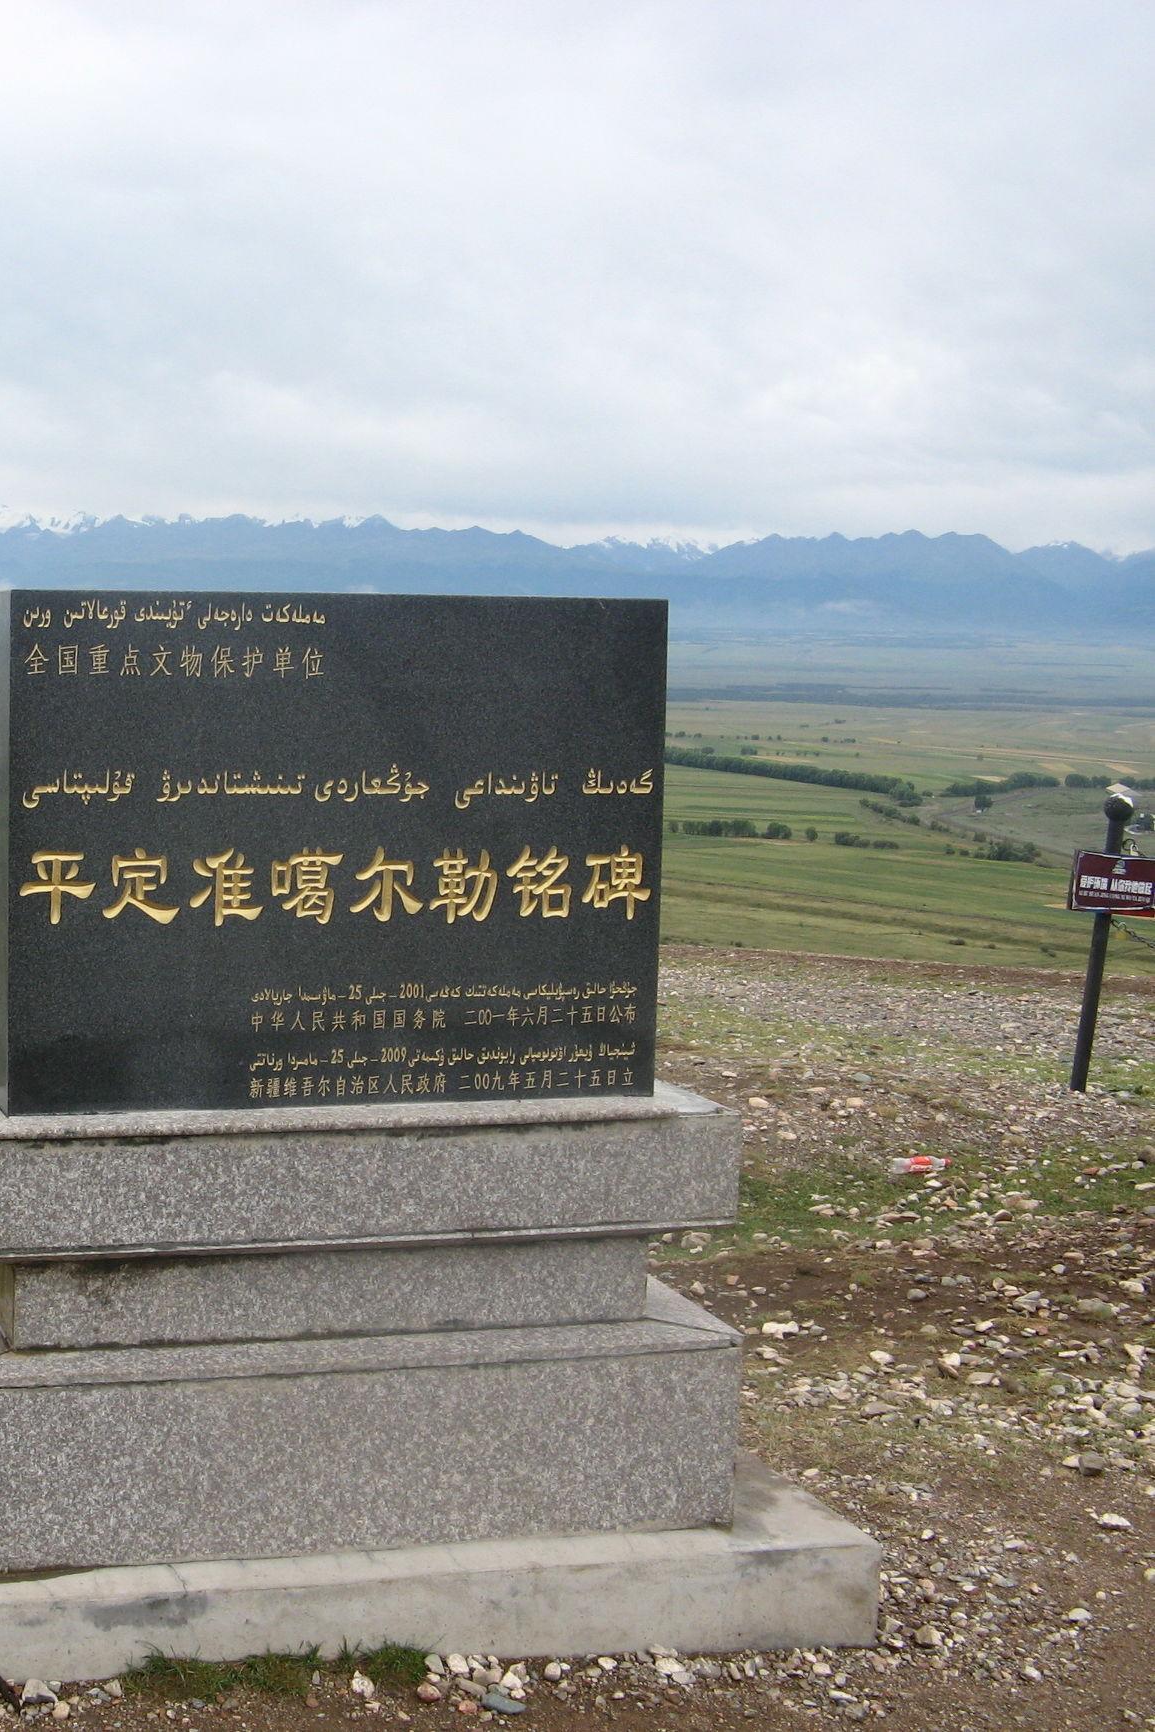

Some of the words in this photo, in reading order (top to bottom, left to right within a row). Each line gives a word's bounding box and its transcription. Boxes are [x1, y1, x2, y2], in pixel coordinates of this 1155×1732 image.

[23, 642, 325, 679] 全国重点文物保护单位
[19, 844, 651, 927] 平定准噶尔勒铭碑
[348, 984, 363, 1000] 25
[399, 983, 424, 999] 2001
[251, 1007, 446, 1033] 中华人民共和国国务院
[330, 1048, 344, 1064] 25
[380, 1047, 407, 1063] 2009
[249, 1072, 446, 1098] 新疆维吾尔自治区人民政府
